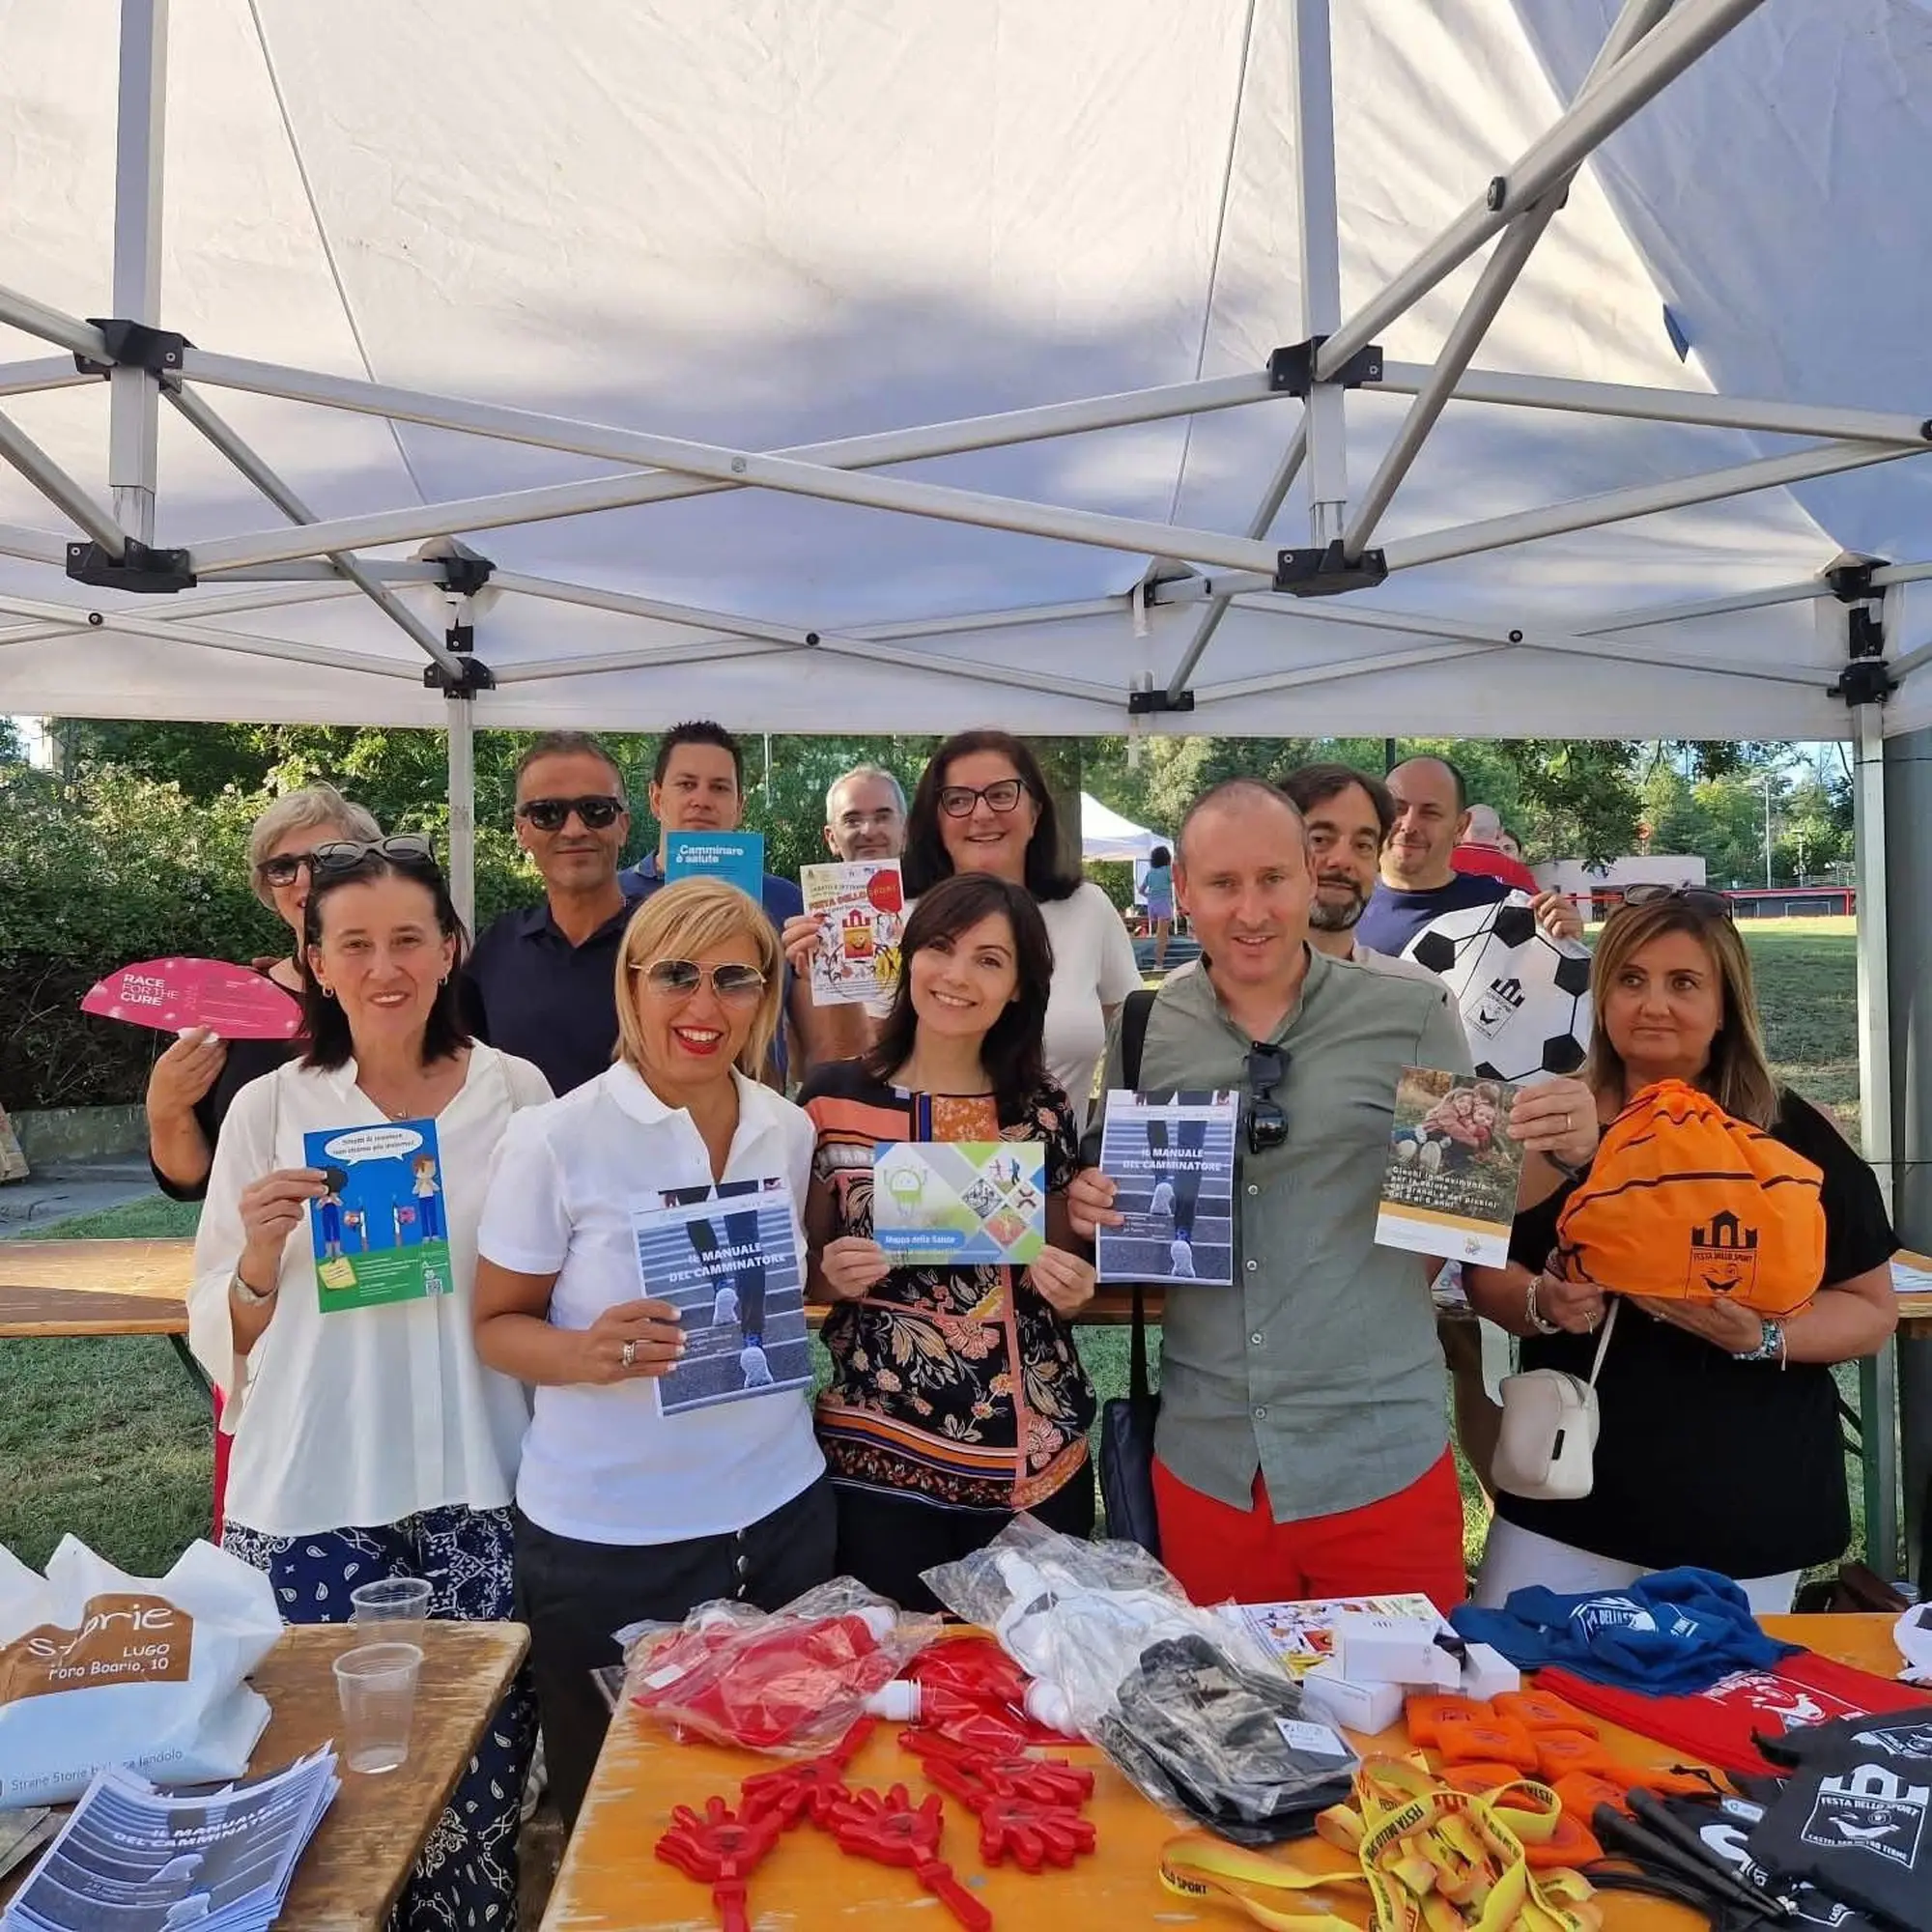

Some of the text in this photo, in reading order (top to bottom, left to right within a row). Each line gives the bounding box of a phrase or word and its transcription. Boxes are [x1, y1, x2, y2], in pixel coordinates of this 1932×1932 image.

[679, 843, 745, 857] Camminare
[123, 973, 166, 989] RACE
[120, 992, 162, 1007] CURE
[122, 982, 180, 1000] FOR THE
[1152, 1148, 1204, 1158] MANUALE
[1122, 1160, 1222, 1172] DEL CAMMINATORE
[701, 1241, 763, 1262] MANUALE
[668, 1253, 786, 1284] DEL CAMMINATORE
[123, 1643, 171, 1658] LUGO
[91, 1661, 146, 1675] Boario,
[152, 1657, 169, 1671] 10
[12, 1778, 50, 1791] Strane
[53, 1770, 87, 1784] Storie
[1820, 1796, 1920, 1817] FESTA DELLO SPORT
[174, 1805, 268, 1837] MANUALE
[1394, 1803, 1425, 1831] FESTA
[113, 1832, 147, 1846] DEL
[1808, 1833, 1836, 1846] CASTEL
[1882, 1844, 1909, 1861] TERME
